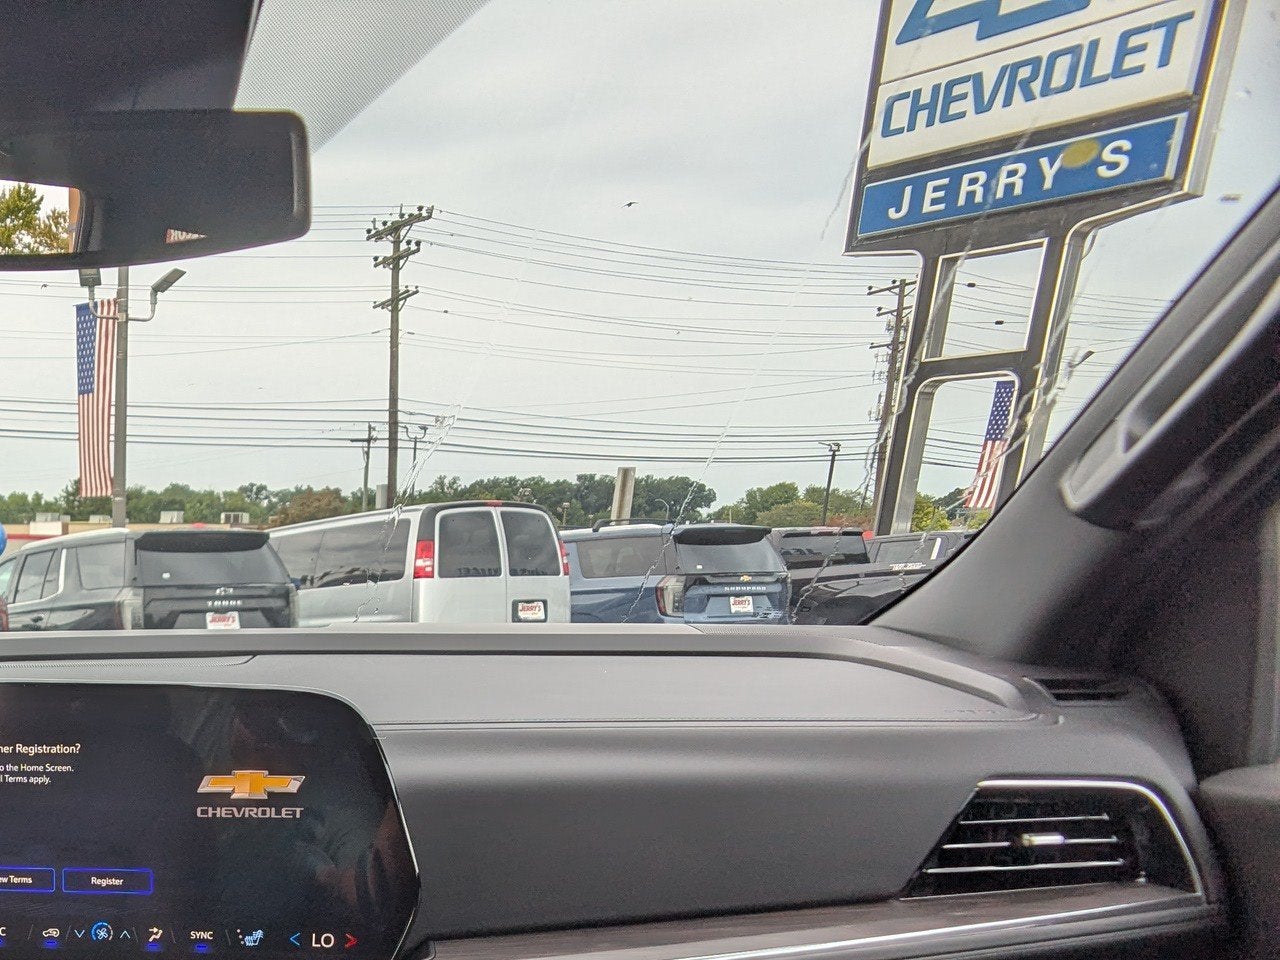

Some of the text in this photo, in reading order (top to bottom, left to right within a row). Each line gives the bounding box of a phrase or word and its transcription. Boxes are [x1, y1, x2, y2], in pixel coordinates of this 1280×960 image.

[881, 11, 1195, 138] CHEVROLET
[886, 139, 1132, 220] JERRYS
[16, 743, 81, 756] Registration?
[6, 764, 19, 772] the
[20, 764, 44, 772] Home
[45, 764, 74, 772] Screen.
[4, 775, 27, 783] Terms
[29, 775, 52, 785] apply.
[196, 806, 305, 818] CHEVROLET
[9, 876, 32, 884] Terms
[91, 876, 124, 887] Register
[190, 931, 214, 940] SYNC
[312, 933, 335, 948] LO
